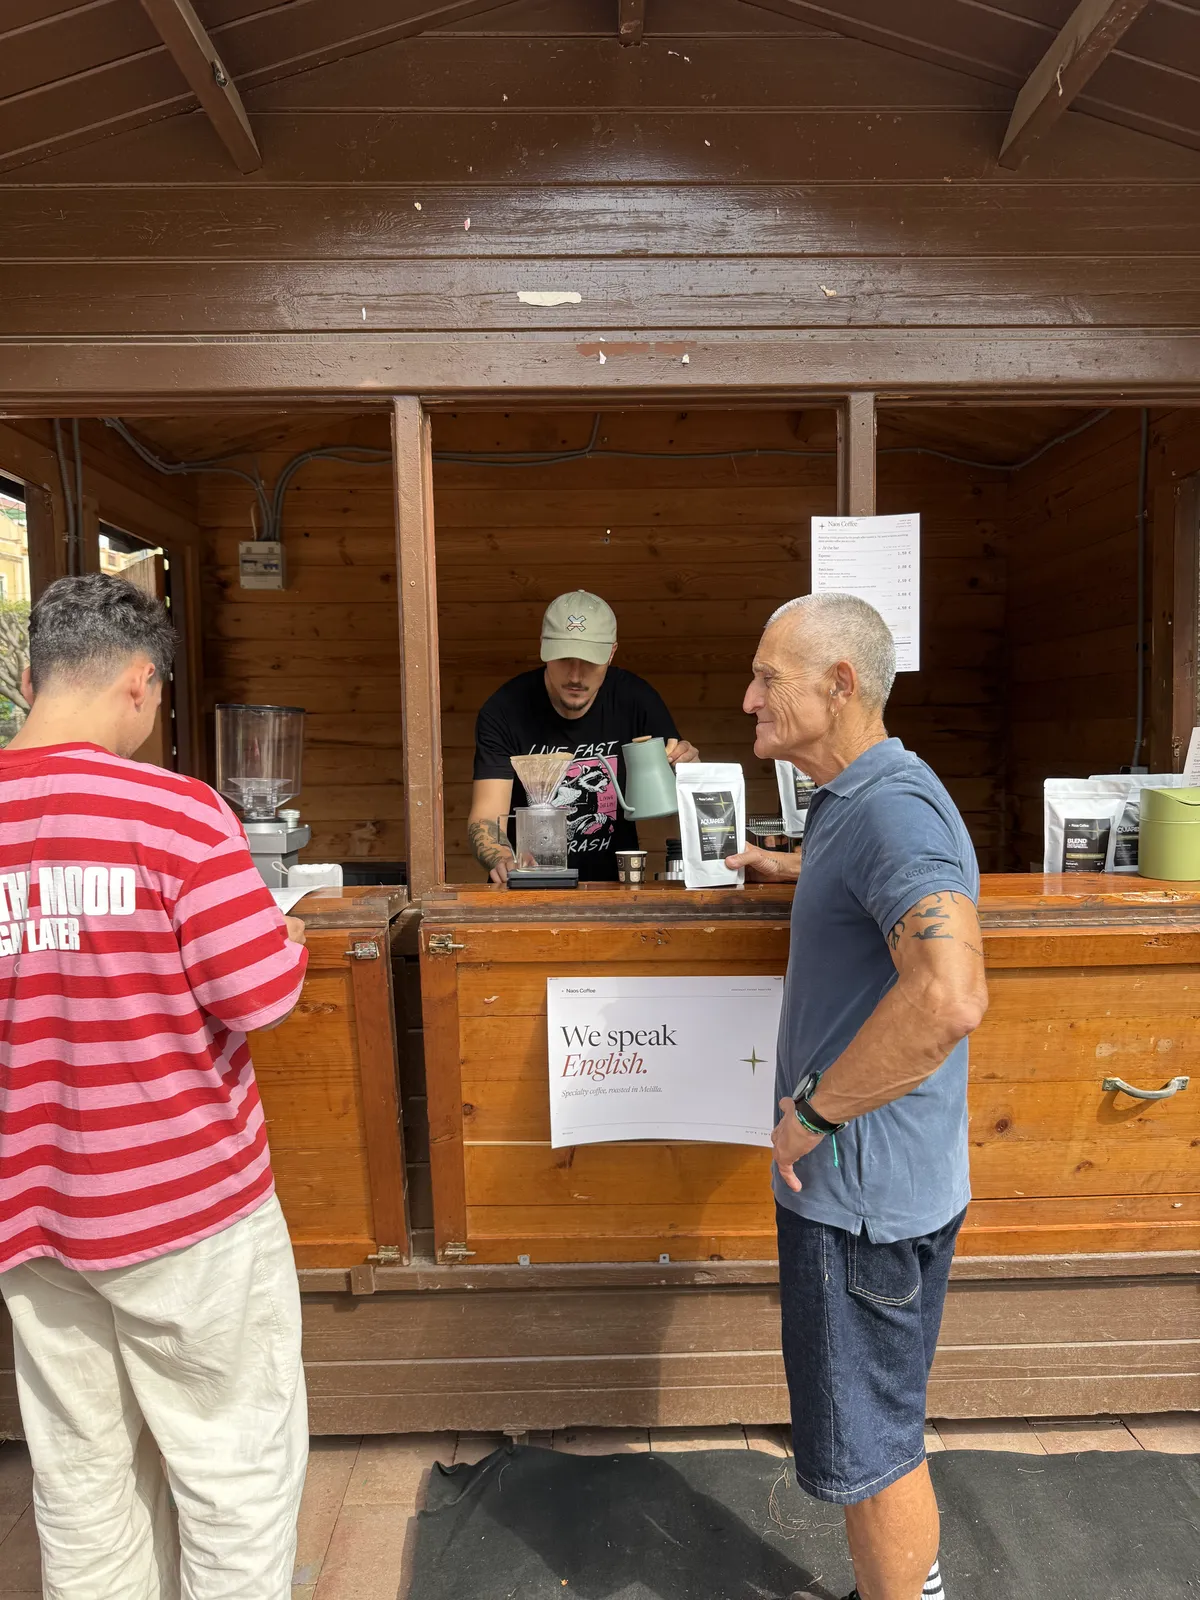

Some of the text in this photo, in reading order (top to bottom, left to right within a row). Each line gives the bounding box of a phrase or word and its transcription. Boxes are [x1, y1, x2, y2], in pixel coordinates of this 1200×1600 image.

[573, 740, 619, 757] FAST
[567, 836, 612, 855] RASH
[38, 866, 136, 916] MOOD
[26, 917, 81, 953] LATER
[560, 1023, 678, 1052] We speak
[560, 1052, 648, 1082] English.
[561, 1087, 590, 1099] Specialty
[589, 1085, 608, 1097] coffee,
[608, 1086, 631, 1094] roasted
[639, 1085, 663, 1093] Melilla.
